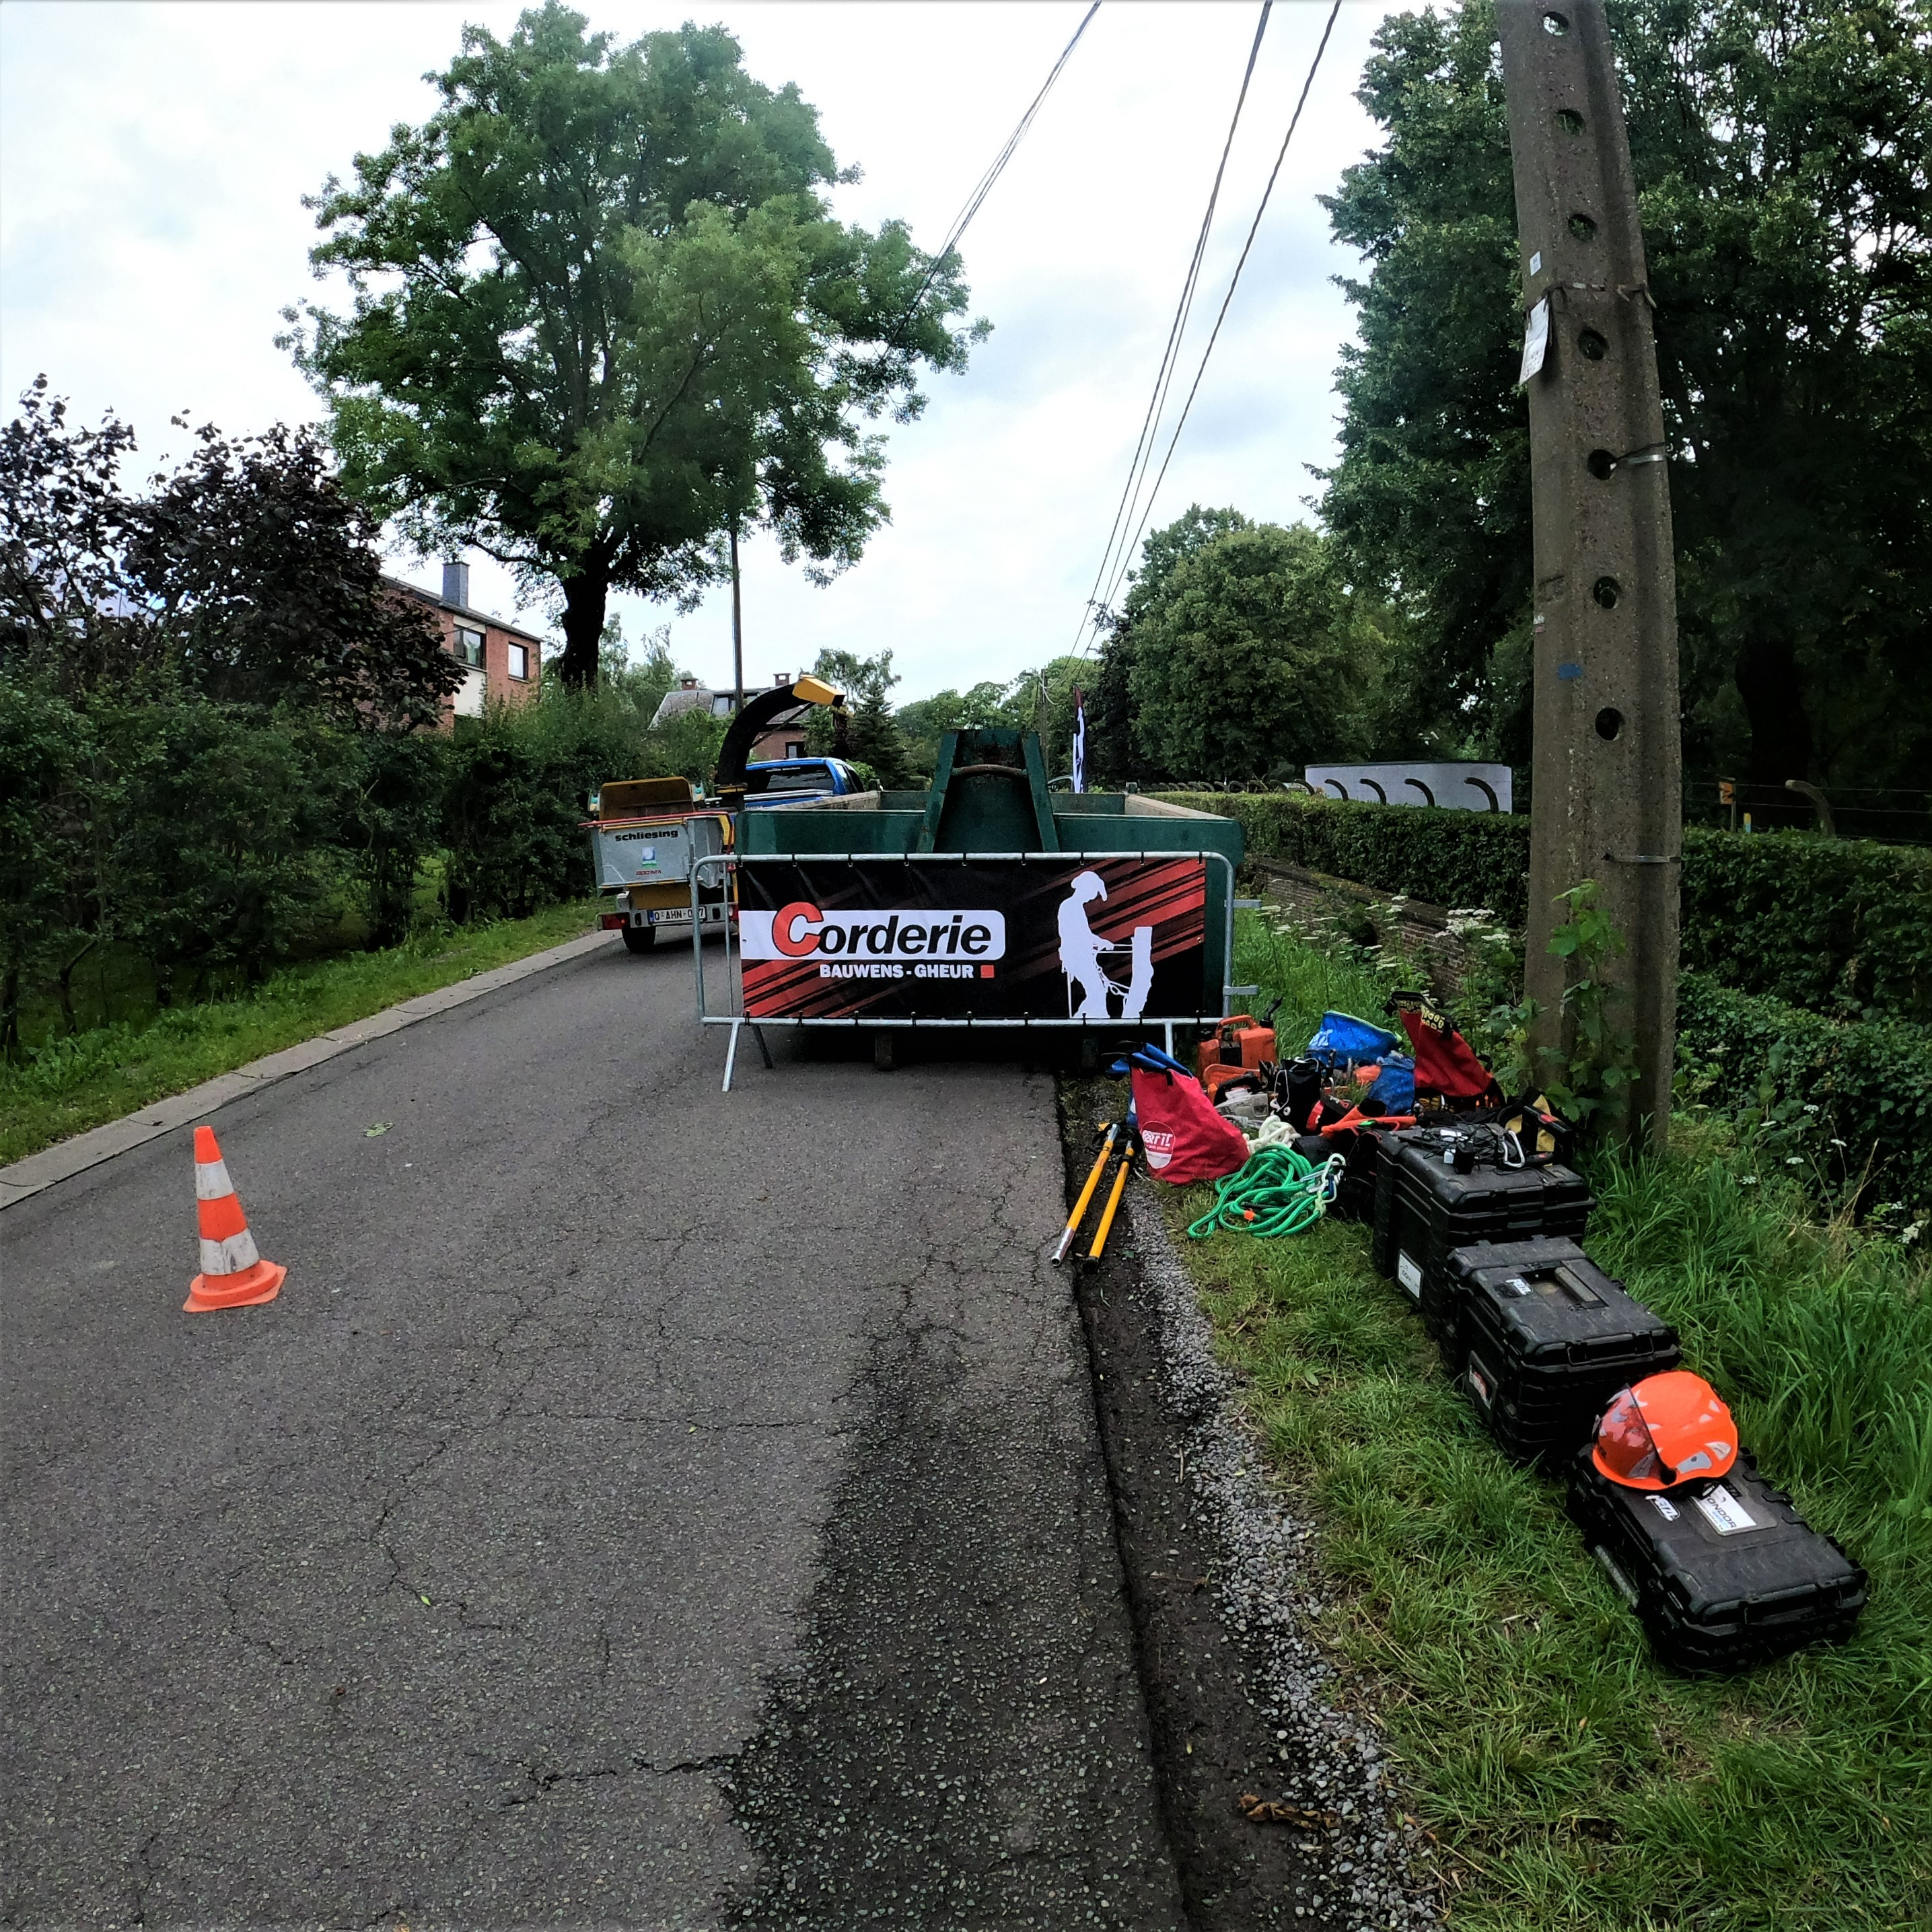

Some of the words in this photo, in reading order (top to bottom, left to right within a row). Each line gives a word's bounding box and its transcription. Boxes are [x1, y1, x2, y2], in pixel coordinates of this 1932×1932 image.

[615, 830, 678, 842] schliesing
[772, 902, 991, 957] Corderie
[1706, 1495, 1737, 1528] ONDOR
